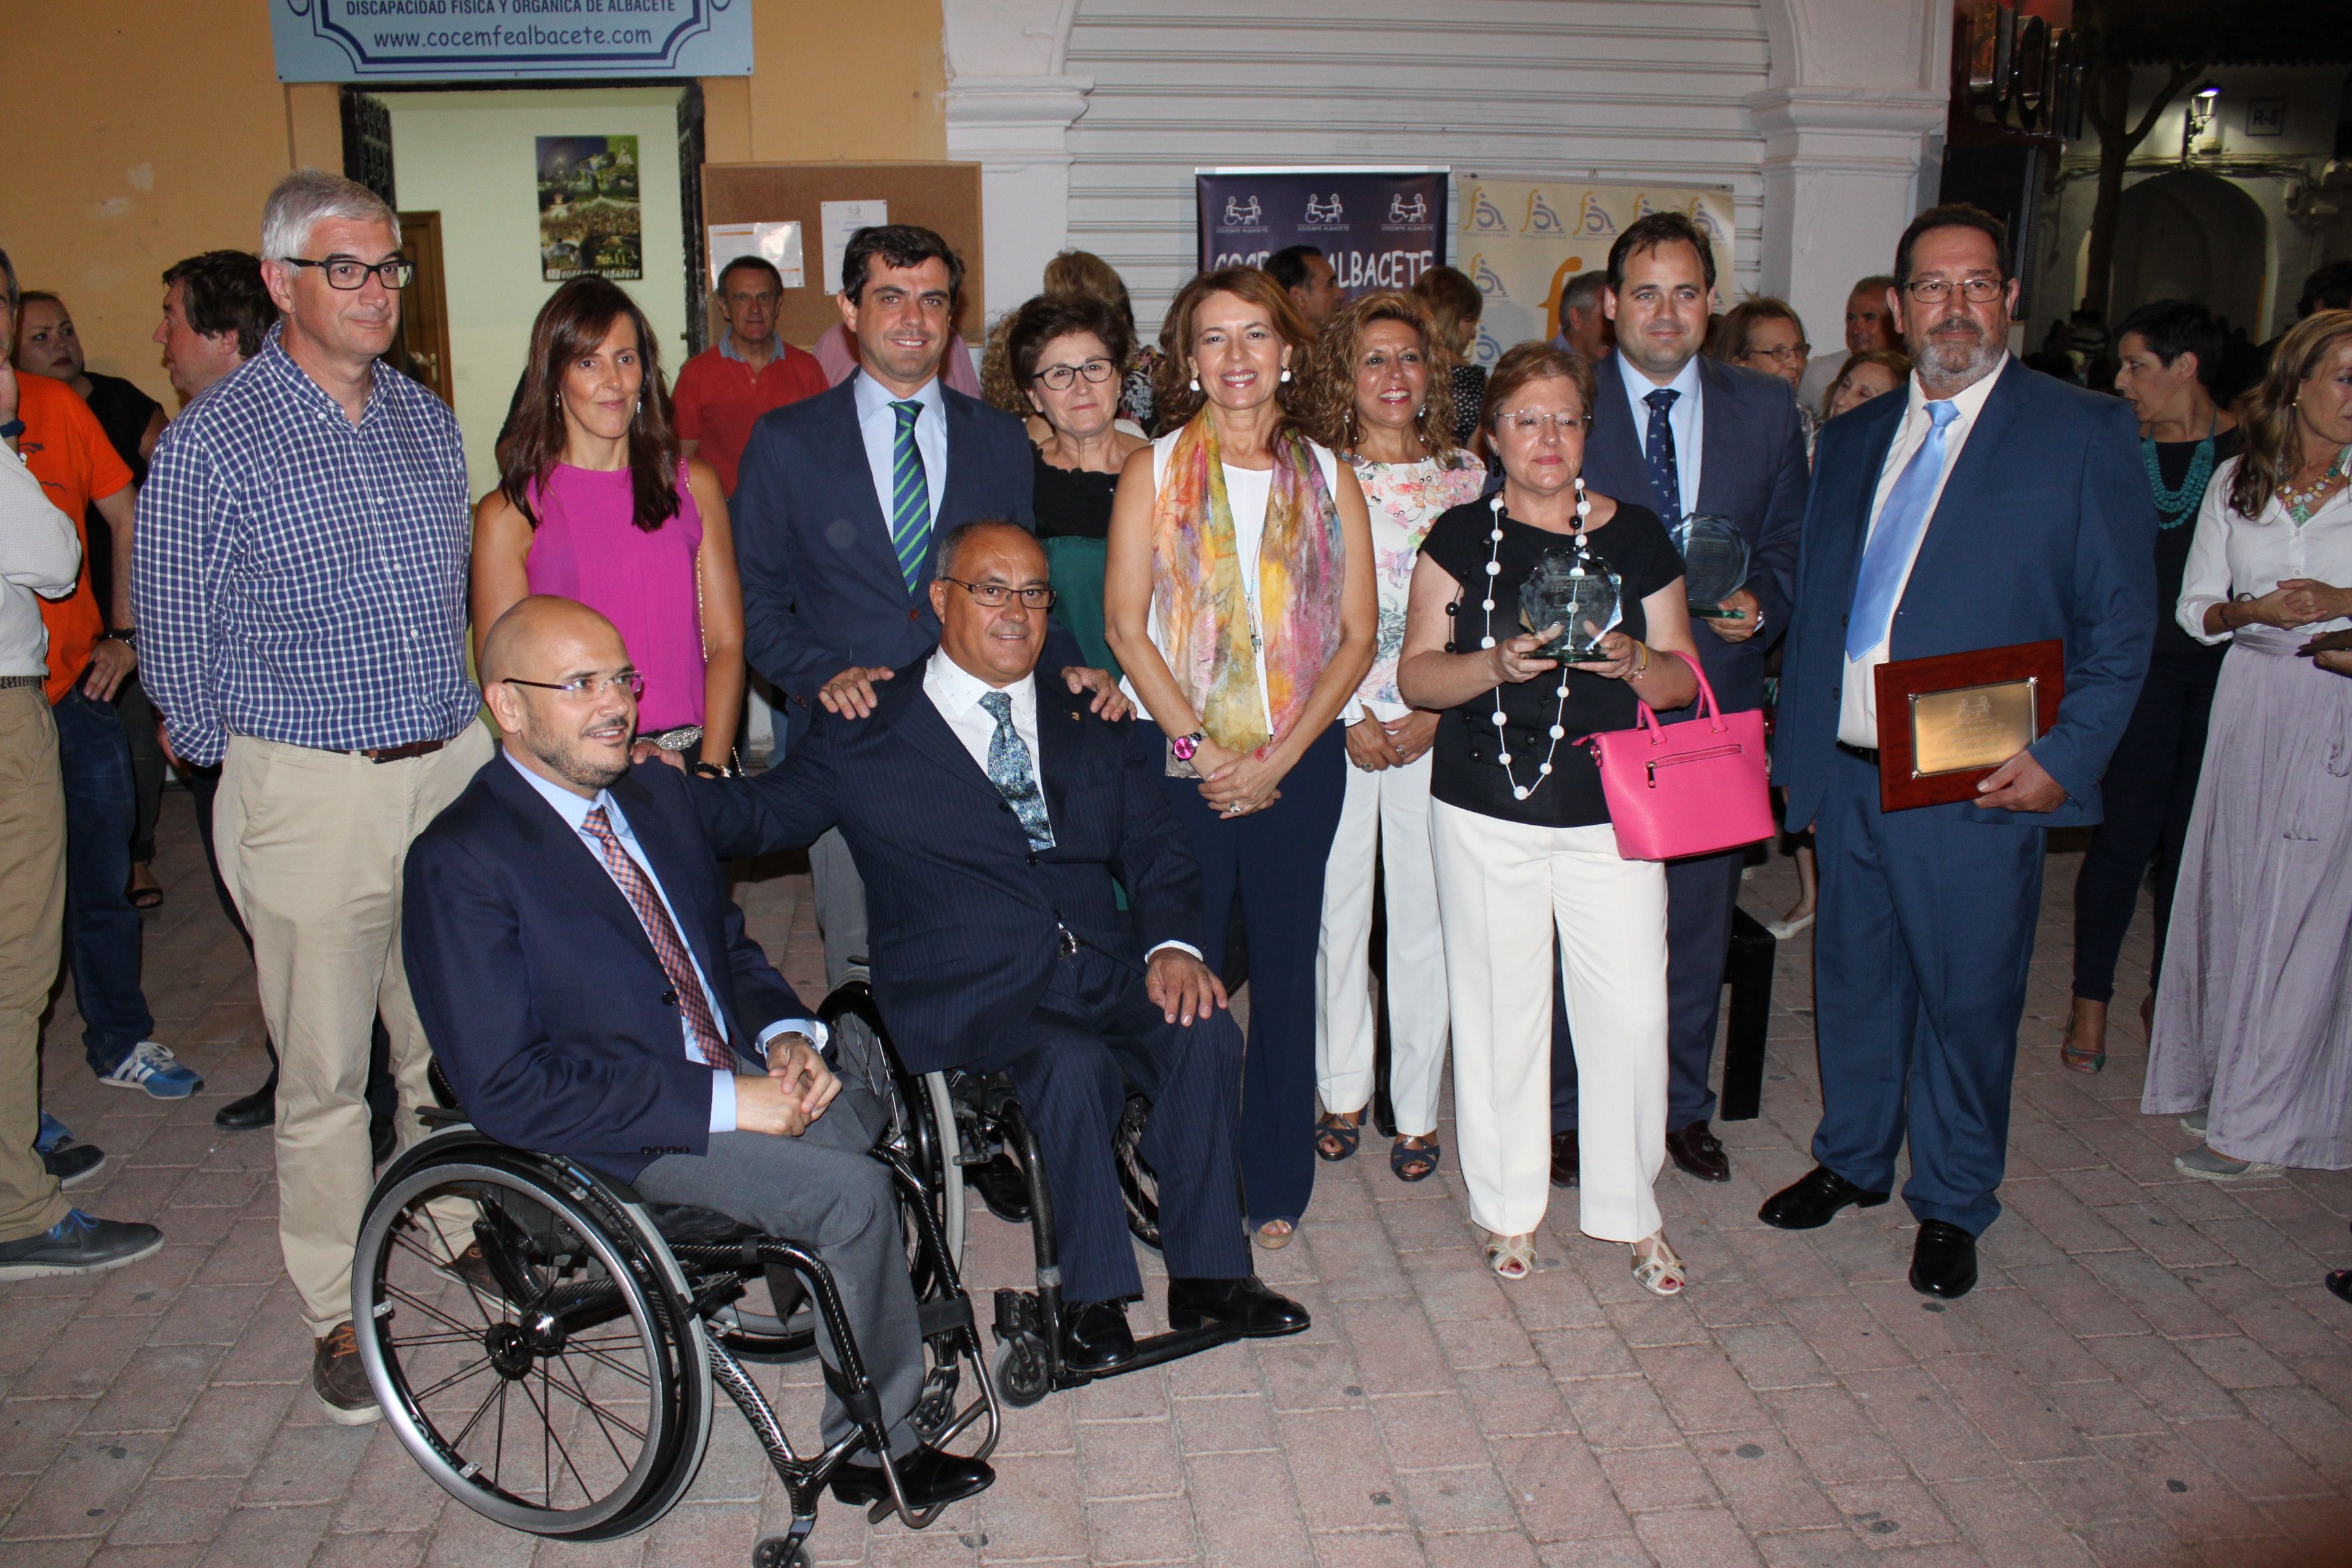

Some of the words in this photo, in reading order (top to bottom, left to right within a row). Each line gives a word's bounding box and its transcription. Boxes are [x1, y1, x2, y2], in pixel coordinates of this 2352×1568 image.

[346, 0, 446, 15] DISCAPACIDAD
[500, 0, 508, 13] Y
[587, 0, 604, 12] DE
[608, 0, 676, 12] ALBACETE
[374, 24, 652, 47] www.cocemfealbacete.com
